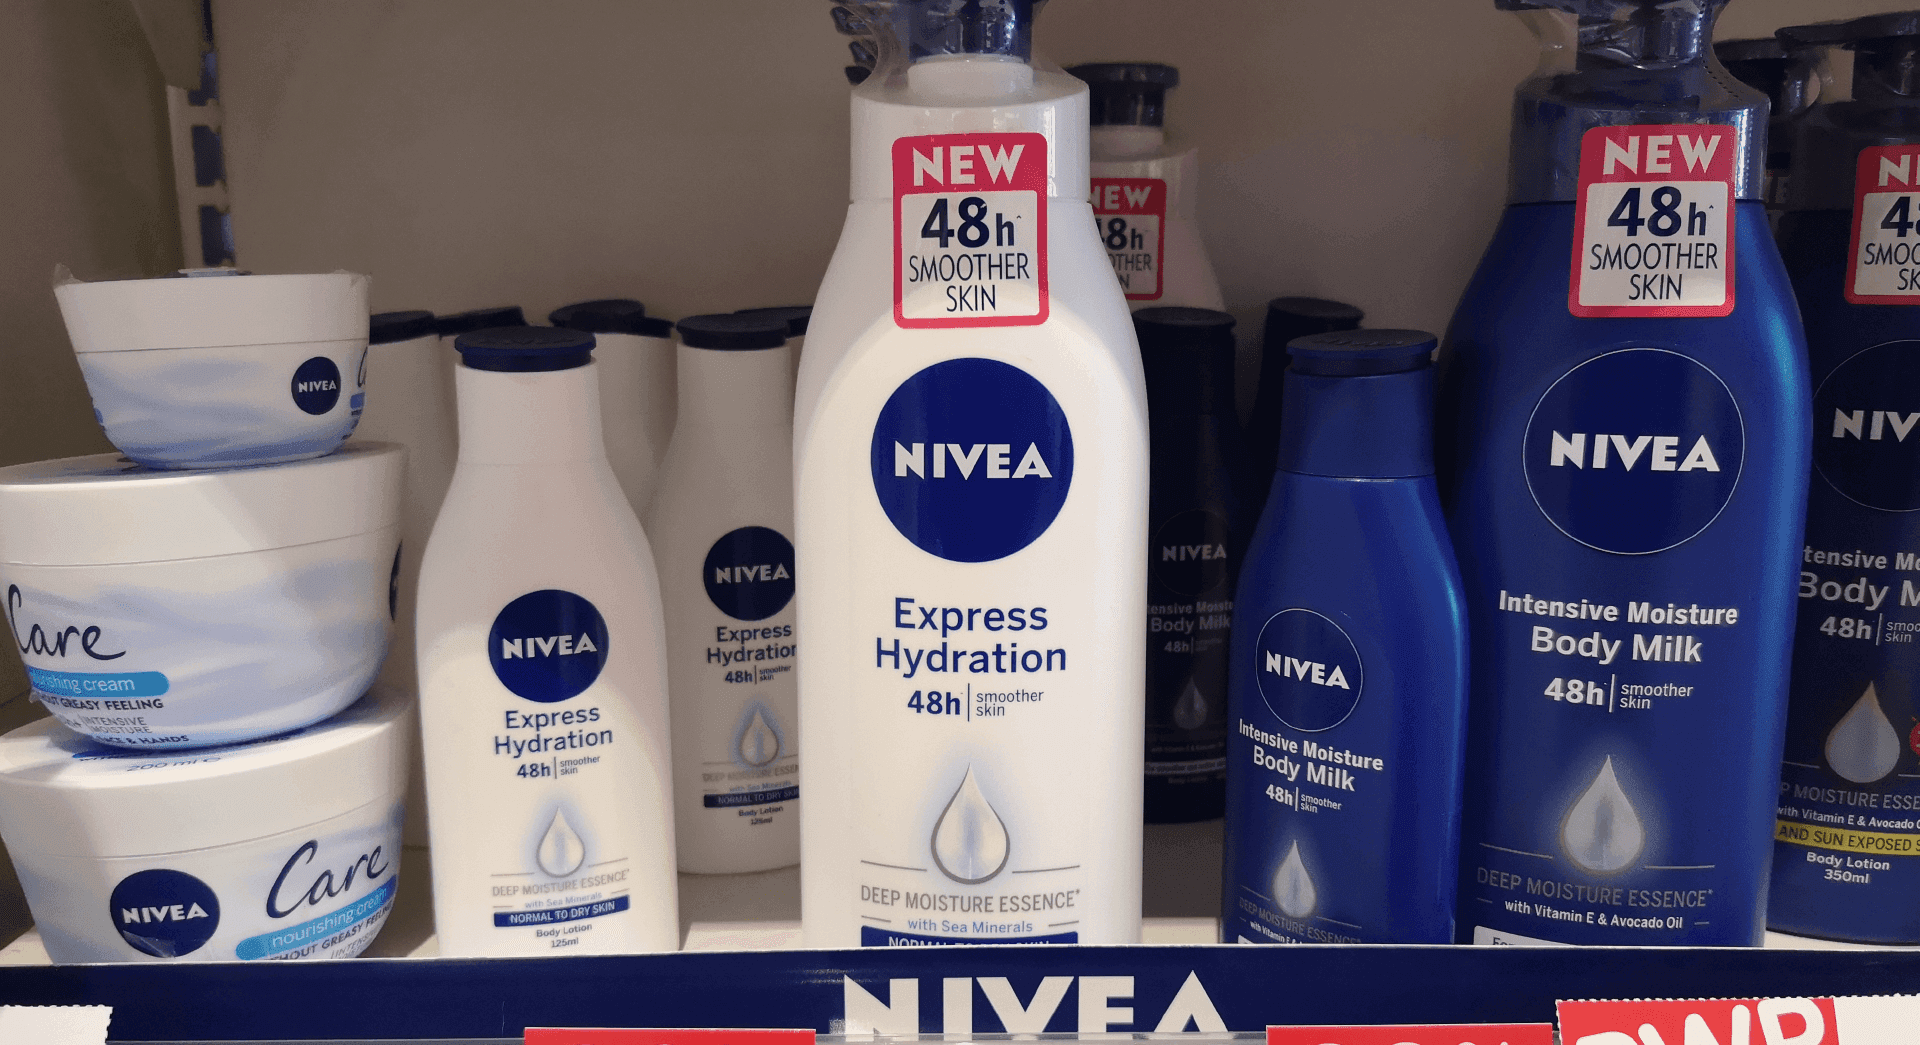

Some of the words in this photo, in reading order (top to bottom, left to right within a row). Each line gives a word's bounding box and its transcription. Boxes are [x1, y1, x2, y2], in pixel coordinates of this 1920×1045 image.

[912, 143, 1026, 187] NEW
[1602, 134, 1722, 176] NEW
[908, 252, 1030, 283] SMOOTHER
[1589, 242, 1719, 271] SMOOTHER
[945, 284, 997, 312] SKIN
[1628, 273, 1683, 301] SKIN
[298, 379, 338, 394] NIVEA
[894, 440, 1053, 481] NIVEA
[1550, 430, 1720, 472] NIVEA
[1162, 543, 1227, 562] NIVEA
[715, 562, 791, 584] NIVEA
[1798, 570, 1889, 612] Body
[894, 597, 1048, 638] Express
[1499, 589, 1620, 623] Intensive
[1627, 601, 1739, 626] Moisture
[8, 583, 127, 661] Care
[716, 624, 793, 645] Express
[1151, 616, 1195, 634] Body
[501, 631, 598, 660] NIVEA
[1531, 625, 1622, 665] Body
[1632, 633, 1703, 663] Milk
[1884, 631, 1912, 643] skin
[876, 637, 1067, 678] Hydration
[1265, 649, 1351, 690] NIVEA
[83, 678, 135, 692] cream
[724, 670, 753, 684] 48h
[1620, 682, 1694, 698] smoother
[60, 697, 100, 711] GREASY
[105, 698, 164, 711] FEELING
[976, 688, 1044, 704] smoother
[1619, 695, 1651, 710] skin
[504, 706, 601, 732] Express
[976, 703, 1005, 717] skin
[139, 734, 190, 745] HANDS
[493, 728, 614, 759] Hydration
[1238, 717, 1299, 754] Intensive
[1302, 739, 1385, 772] Moisture
[516, 762, 551, 779] 48h
[559, 755, 601, 768] smoother
[560, 766, 579, 776] skin
[1253, 744, 1301, 782] Body
[1306, 761, 1356, 792] Milk
[1265, 783, 1294, 807] 48h
[1300, 793, 1342, 811] smoother
[1300, 802, 1318, 814] skin
[1794, 785, 1879, 809] MOISTURE
[1801, 808, 1845, 824] Vitamin
[1847, 814, 1855, 825] E
[1856, 815, 1866, 827] &
[1869, 816, 1915, 830] Avocado
[1778, 824, 1809, 841] AND
[1813, 829, 1844, 847] SUN
[1847, 834, 1912, 852] EXPOSED
[1806, 851, 1843, 868] Body
[1846, 856, 1891, 871] Lotion
[265, 839, 390, 919] Care
[492, 884, 520, 898] DEEP
[522, 879, 579, 896] MOISTURE
[1477, 866, 1522, 891] DEEP
[1526, 876, 1623, 907] MOISTURE
[1824, 868, 1871, 884] 350ml
[524, 900, 544, 909] with
[860, 884, 901, 907] DEEP
[905, 890, 995, 913] MOISTURE
[122, 901, 210, 924] NIVEA
[272, 909, 355, 948] nourishing
[356, 886, 388, 916] cream
[510, 911, 553, 924] NORMAL
[554, 910, 569, 921] TO
[570, 906, 591, 919] DRY
[592, 900, 616, 915] SKIN
[1258, 907, 1305, 937] MOISTURE
[1504, 899, 1531, 915] with
[1534, 903, 1583, 923] Vitamin
[1586, 911, 1595, 925] E
[1597, 912, 1608, 926] &
[1610, 914, 1664, 930] Avocado
[1666, 915, 1684, 929] Oil
[321, 923, 364, 949] GREASY
[536, 928, 561, 939] Body
[563, 924, 593, 936] Lotion
[907, 918, 937, 932] with
[941, 919, 963, 933] Sea
[972, 920, 1034, 934] Minerals
[551, 937, 579, 948] 125ml
[844, 969, 1228, 1036] NIVEA
